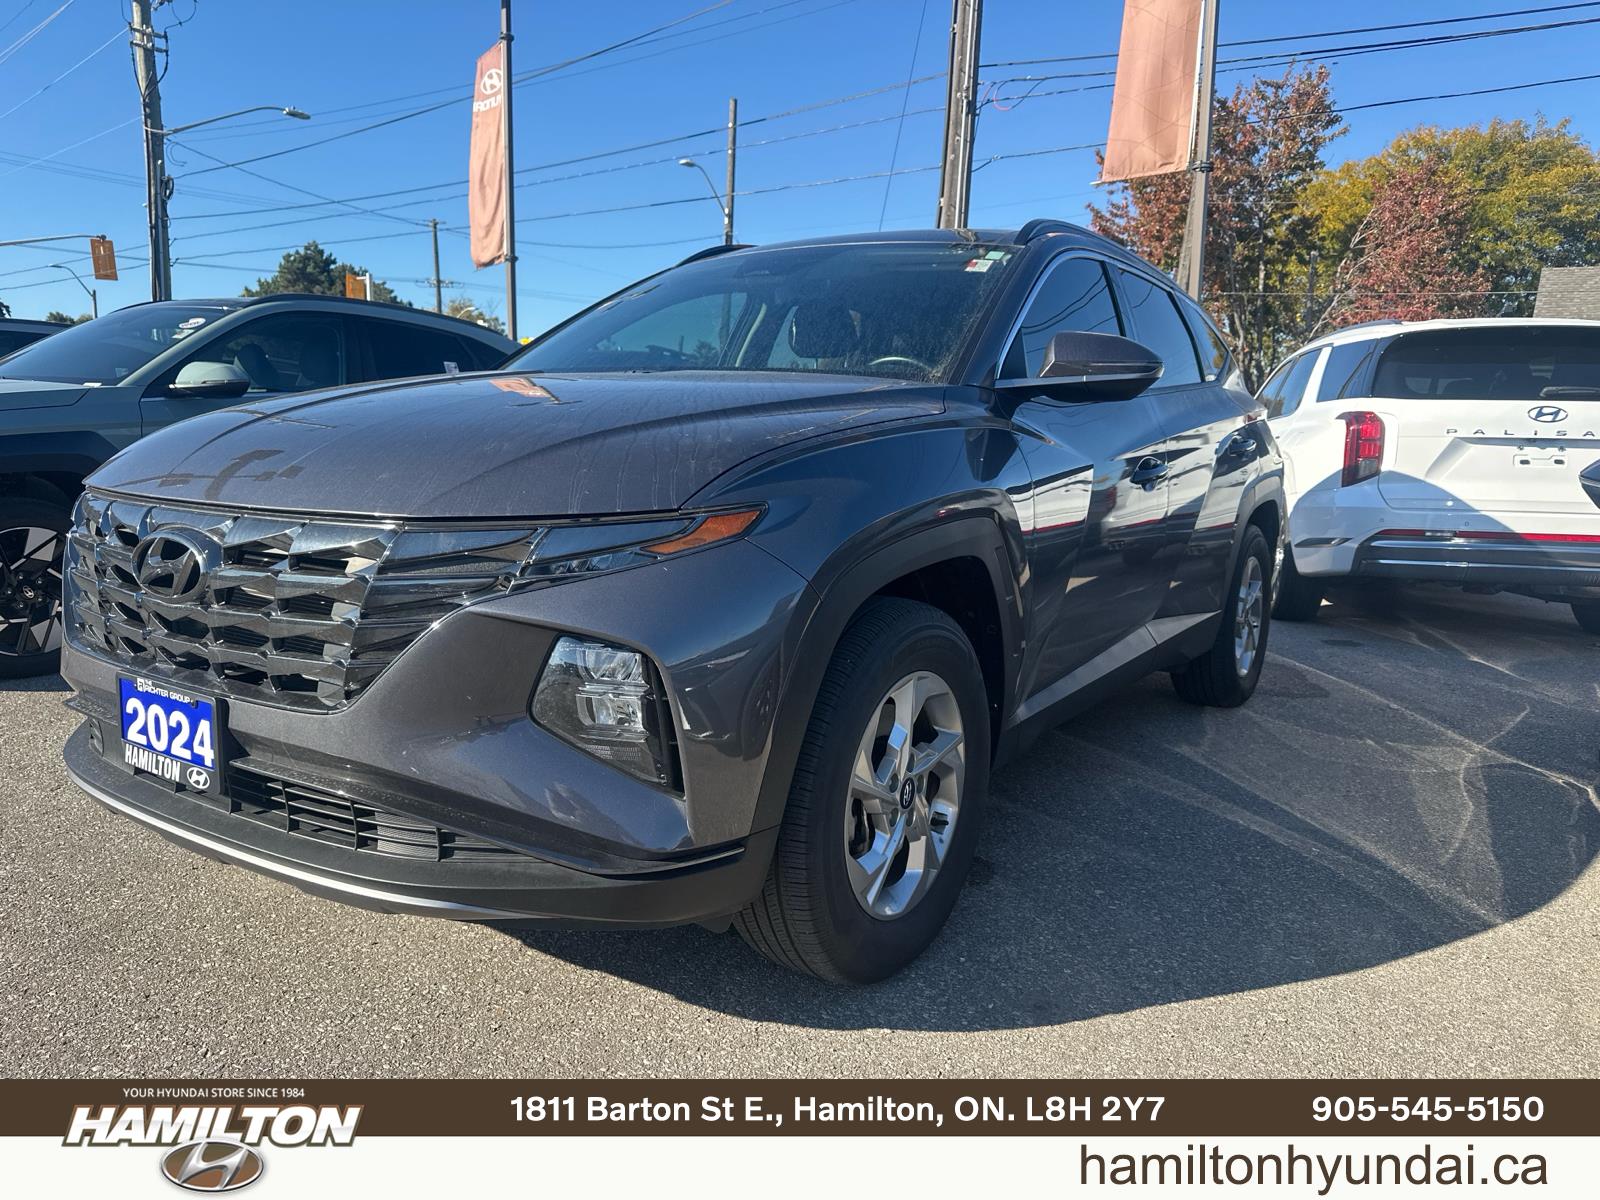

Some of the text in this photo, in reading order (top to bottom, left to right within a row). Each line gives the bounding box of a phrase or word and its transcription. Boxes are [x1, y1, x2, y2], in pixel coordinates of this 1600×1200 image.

[169, 691, 191, 704] GROUP
[125, 697, 215, 768] 2024
[124, 743, 181, 782] HAMILTON
